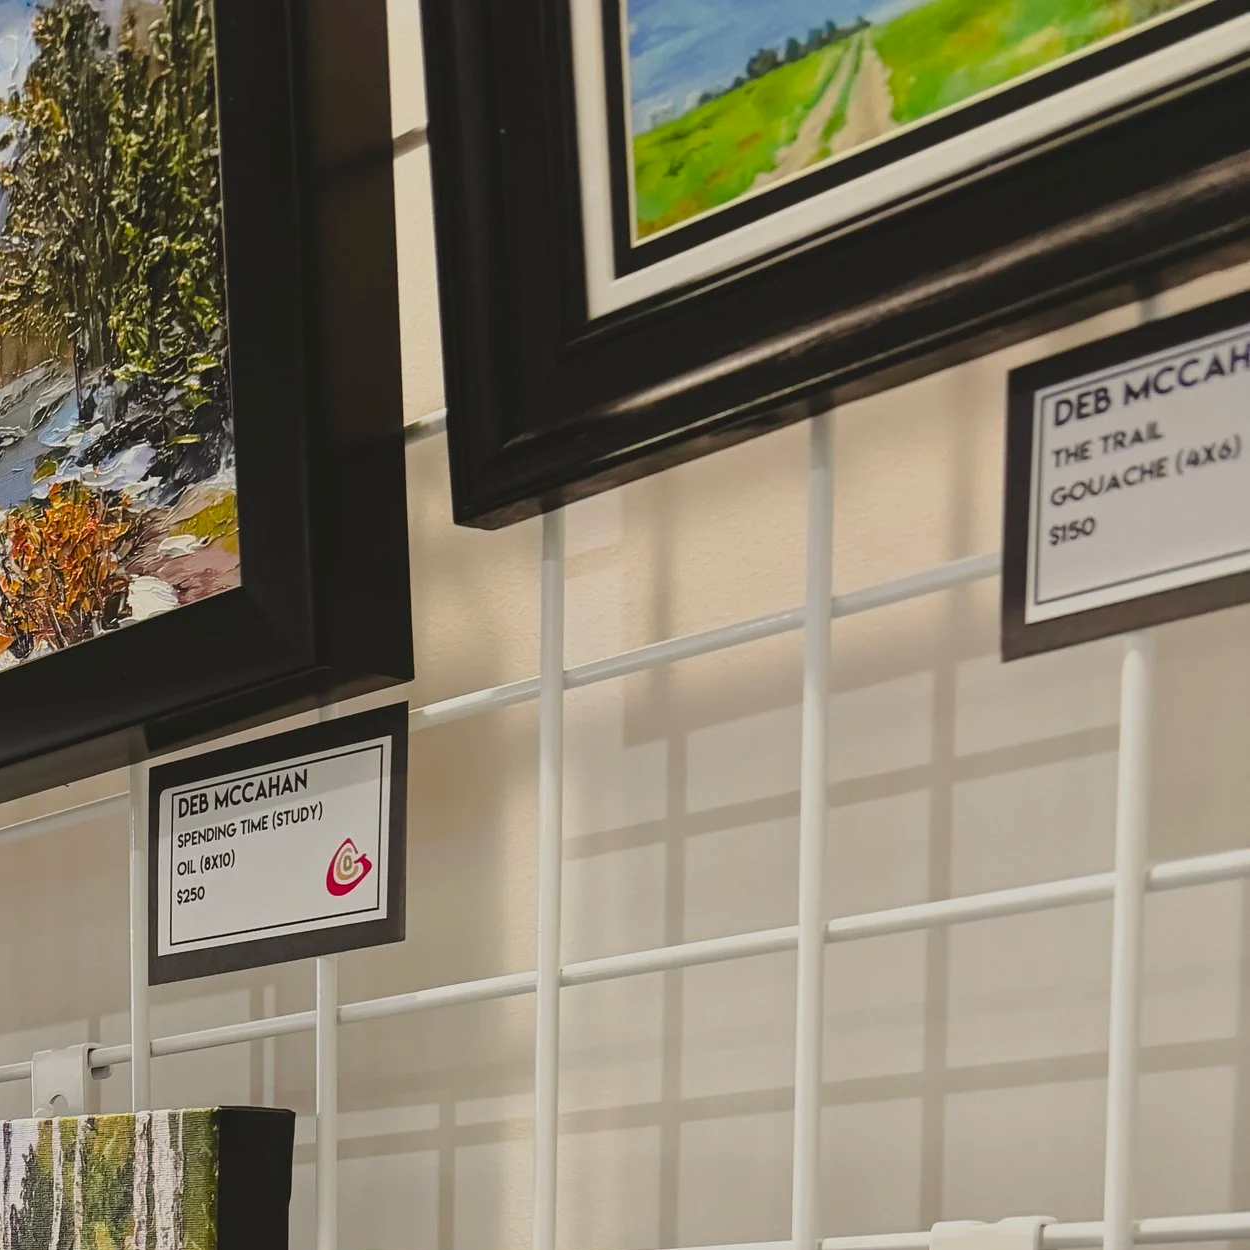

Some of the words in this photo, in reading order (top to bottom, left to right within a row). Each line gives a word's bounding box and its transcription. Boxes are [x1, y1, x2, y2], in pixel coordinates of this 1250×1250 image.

[1053, 386, 1112, 427] DEB
[1053, 439, 1092, 469] THE
[1101, 420, 1165, 455] TRAIL
[1050, 456, 1169, 507] GOUACHE
[1174, 434, 1243, 476] (4X6)
[1048, 516, 1097, 547] $150
[177, 792, 209, 819] DEB
[214, 768, 309, 811] MCCAHAN
[176, 821, 237, 849] SPENDING
[240, 814, 269, 835] TIME
[272, 800, 324, 831] (STUDY)
[176, 858, 197, 876] OIL
[200, 848, 236, 875] (8X10)
[176, 885, 206, 906] $250
